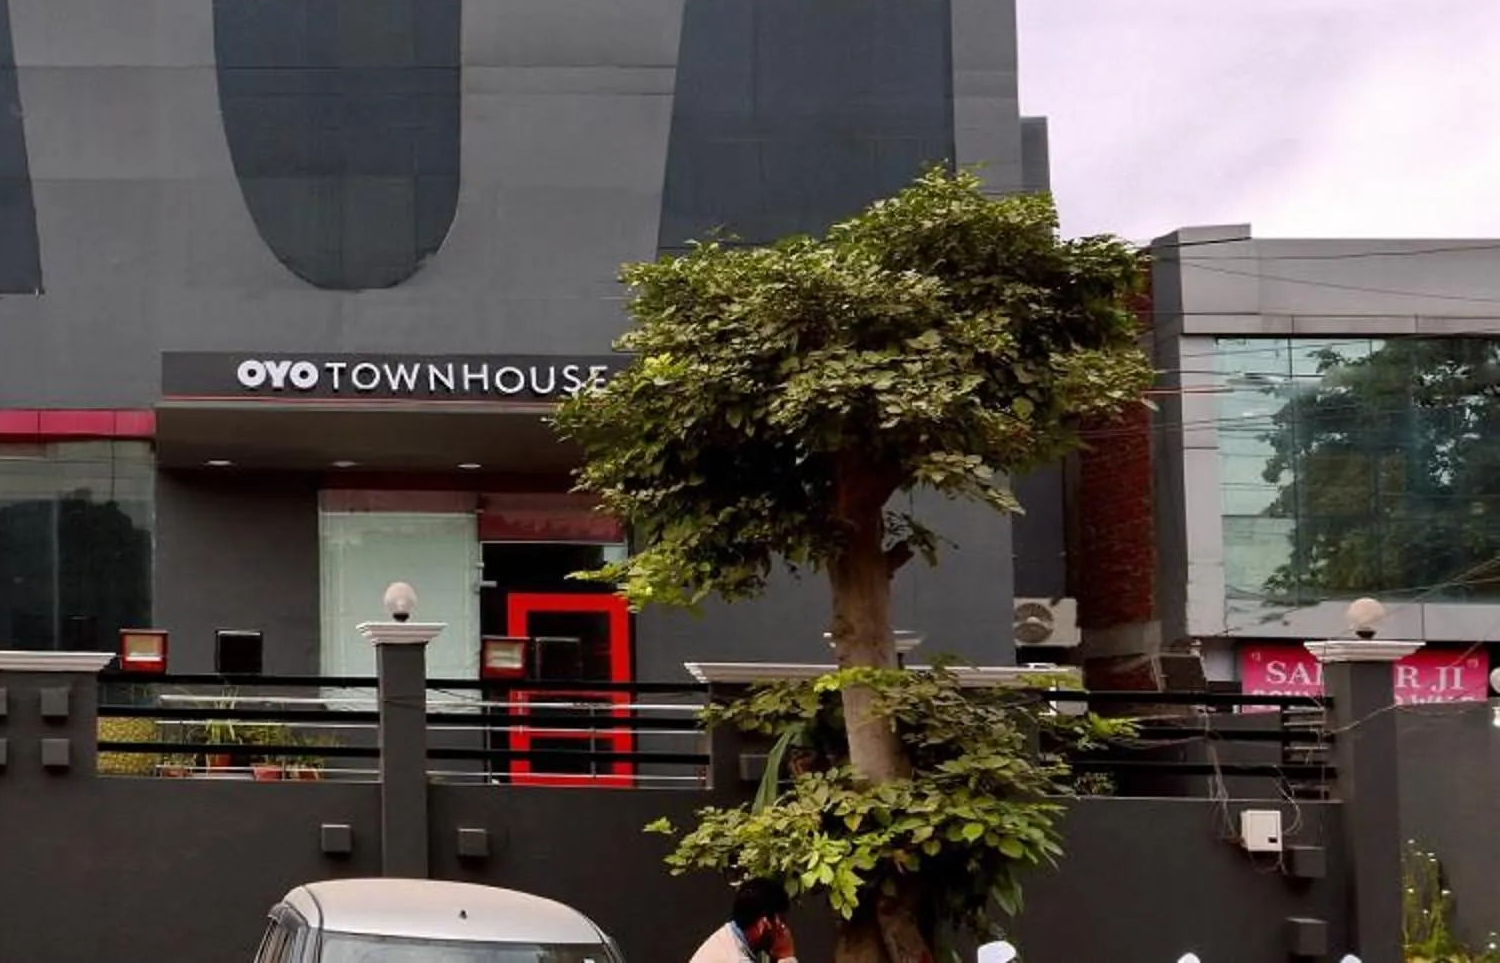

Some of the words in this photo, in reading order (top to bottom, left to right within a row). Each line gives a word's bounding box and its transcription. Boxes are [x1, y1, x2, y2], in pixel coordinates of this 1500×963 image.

[237, 359, 319, 390] OYO
[324, 362, 609, 395] TOWNHOUSE
[1431, 666, 1466, 693] JI
